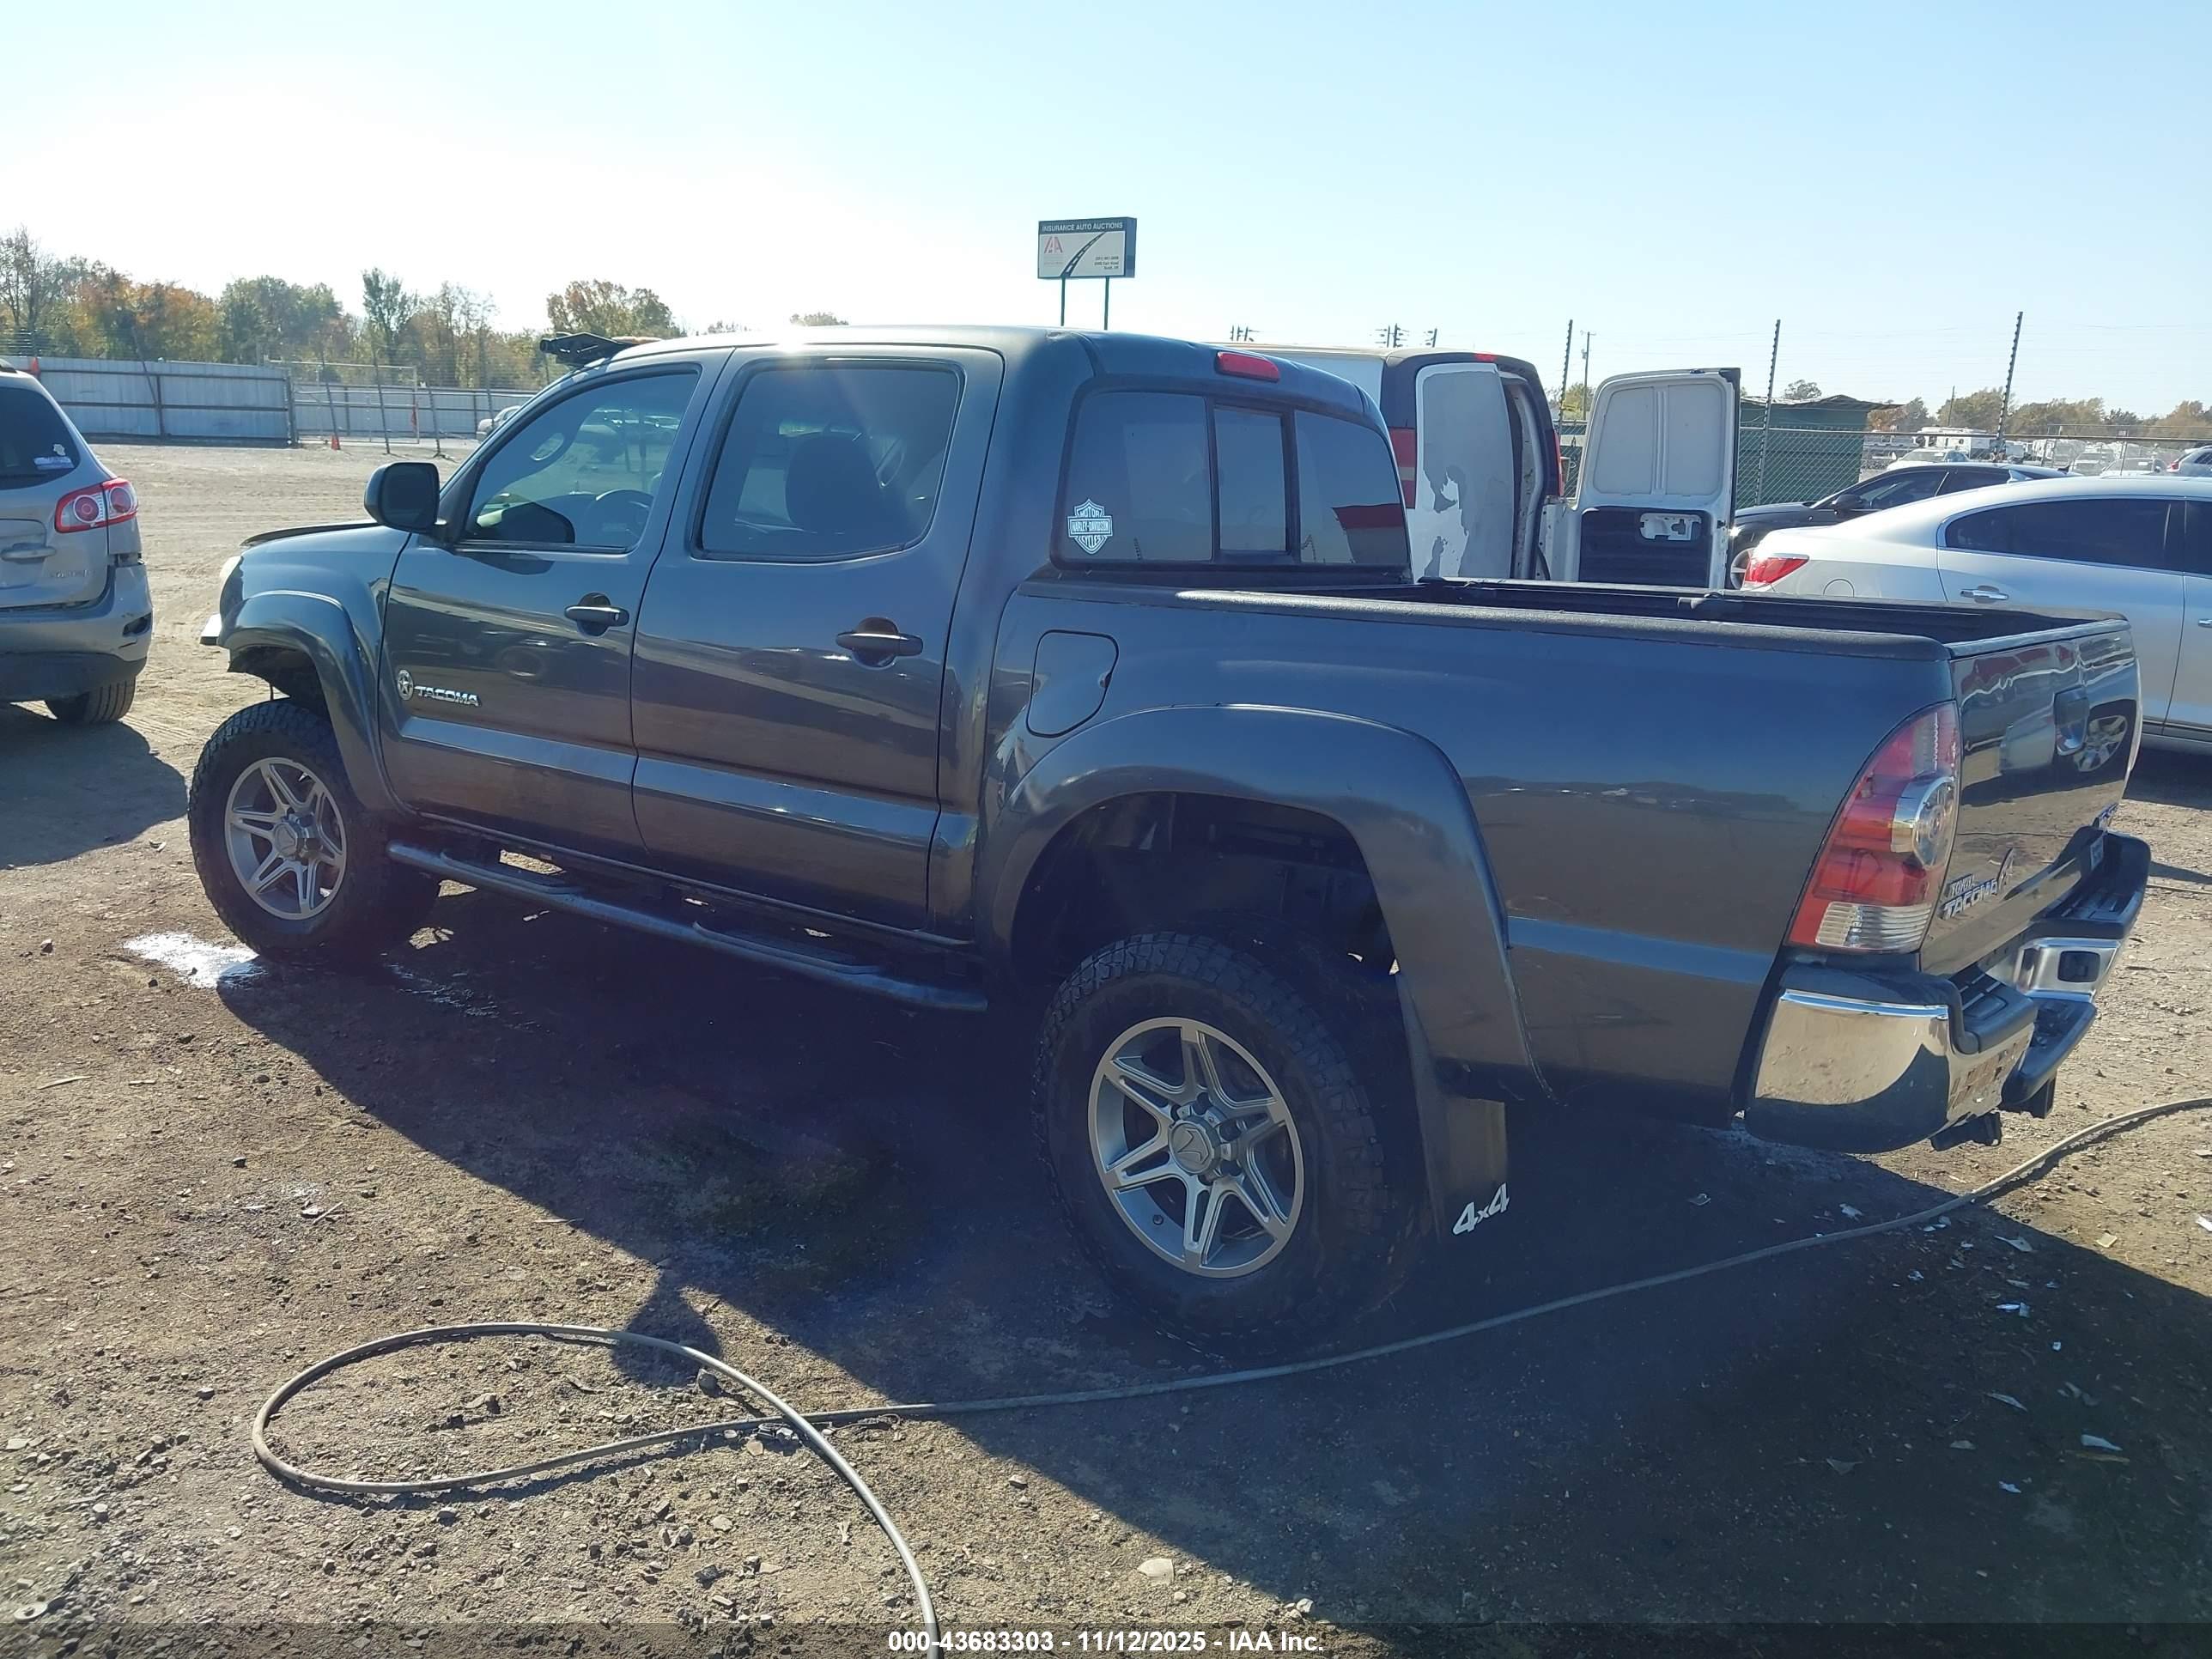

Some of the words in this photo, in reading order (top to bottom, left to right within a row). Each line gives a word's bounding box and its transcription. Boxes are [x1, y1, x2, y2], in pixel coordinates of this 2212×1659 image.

[1093, 222, 1123, 230] AUCTIONS
[414, 685, 480, 707] TACOMA
[1942, 878, 1998, 921] TACOMA
[1452, 1182, 1510, 1236] 4x4
